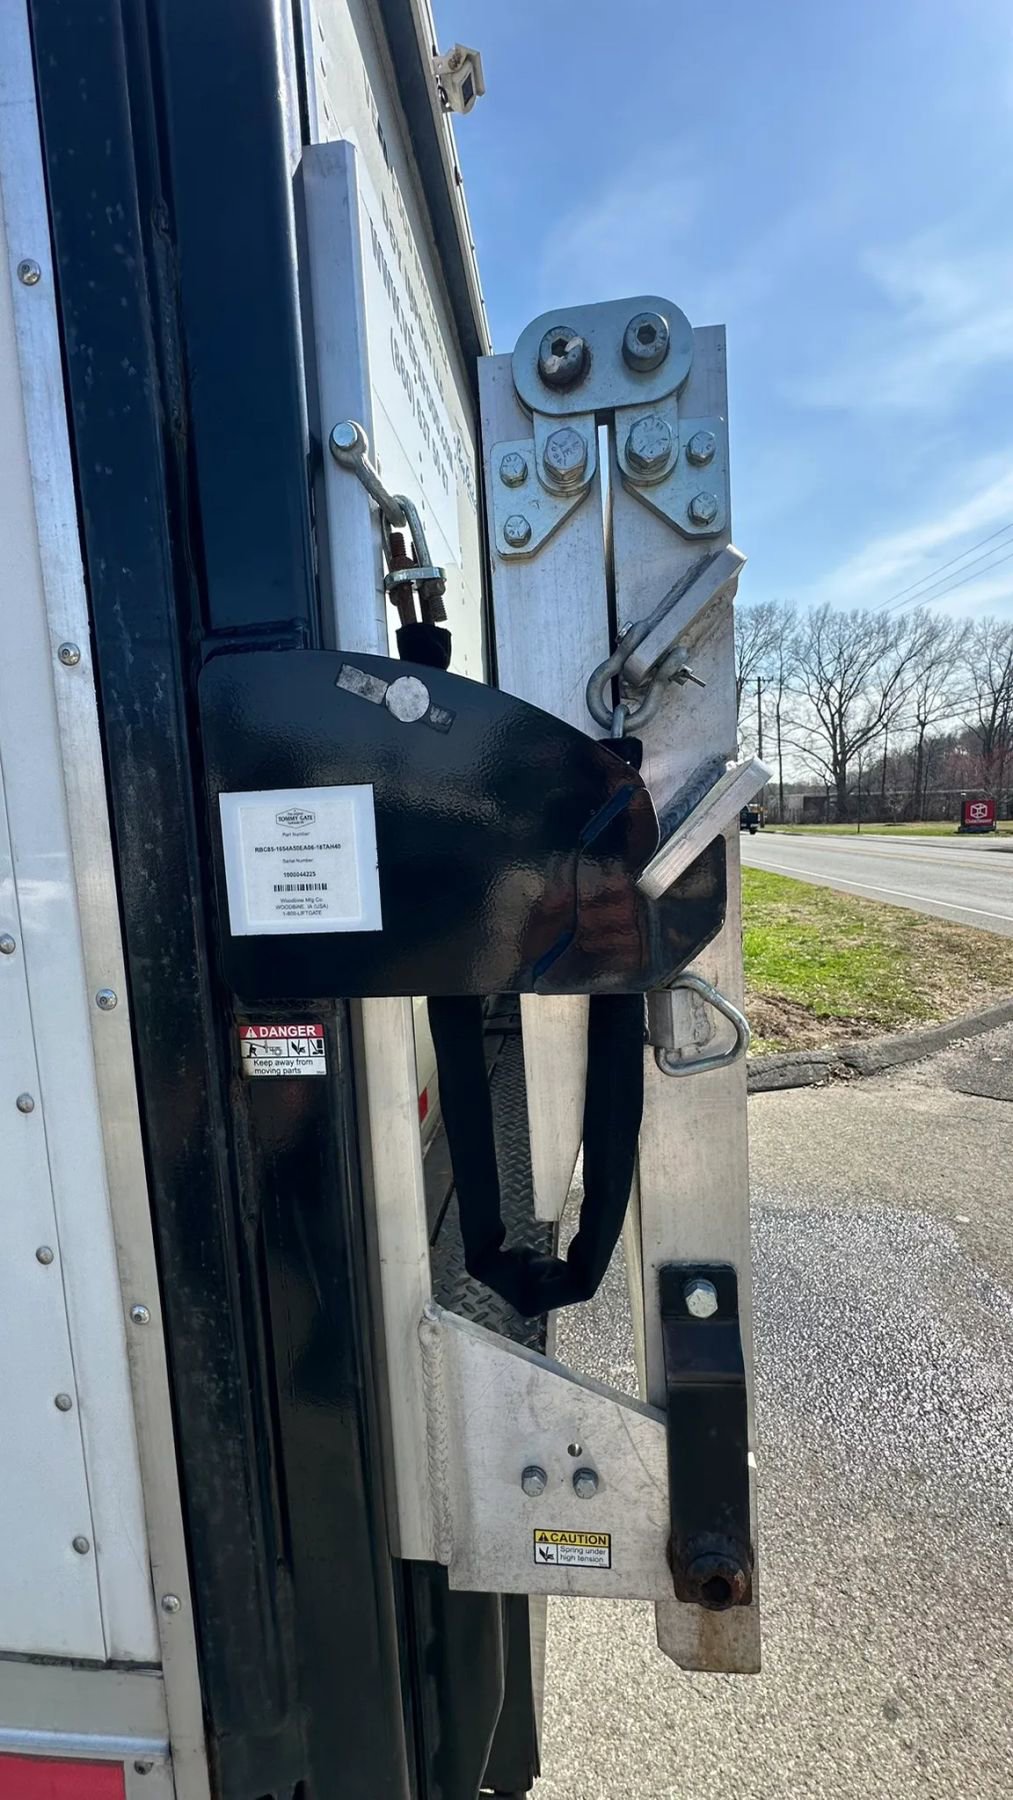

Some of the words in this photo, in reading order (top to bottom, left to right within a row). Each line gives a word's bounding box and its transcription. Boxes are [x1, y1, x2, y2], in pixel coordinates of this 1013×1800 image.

[259, 1025, 316, 1038] DANGER
[253, 1059, 273, 1067] Keep
[254, 1067, 281, 1075] moving
[282, 1067, 301, 1075] parts
[550, 1533, 607, 1545] CAUTION
[560, 1546, 584, 1555] Spring
[560, 1554, 576, 1562] high
[577, 1555, 604, 1563] tension
